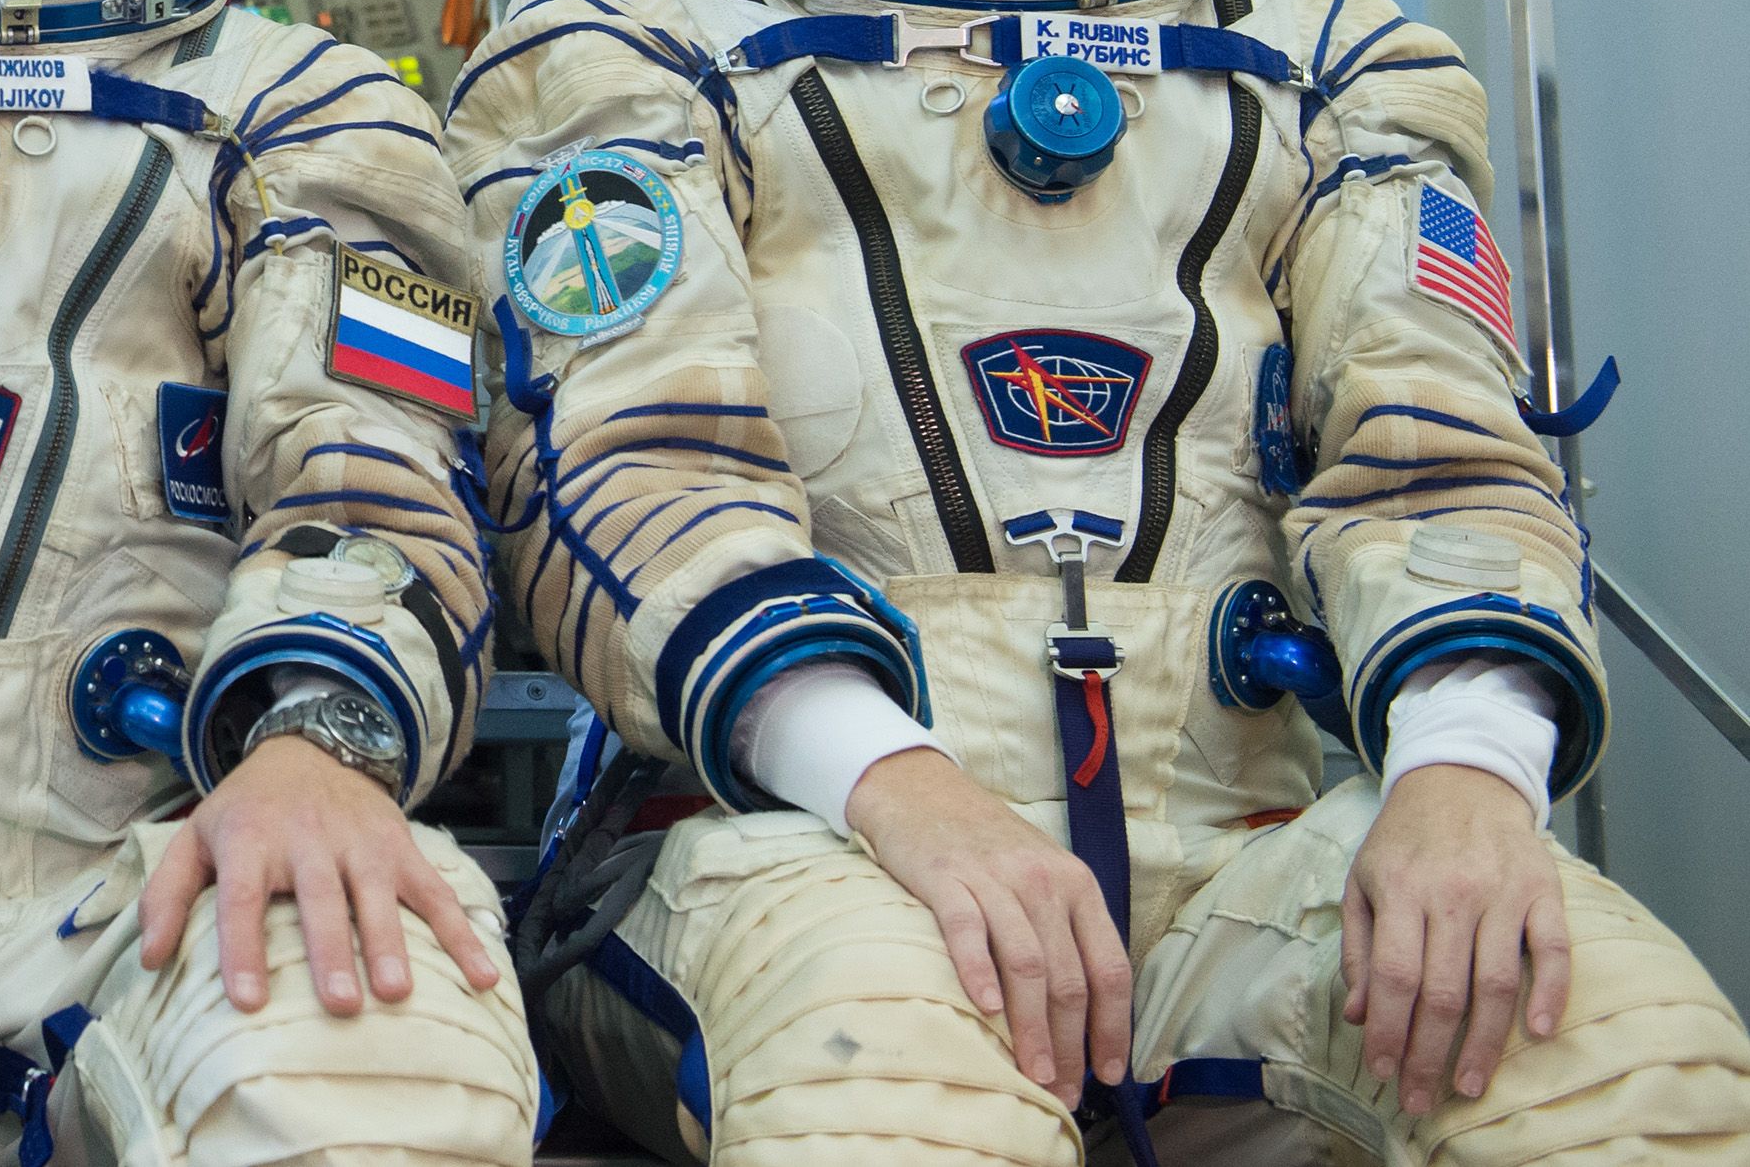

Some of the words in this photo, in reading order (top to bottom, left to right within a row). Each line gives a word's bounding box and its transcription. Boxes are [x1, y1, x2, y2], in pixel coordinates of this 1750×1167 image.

[1037, 19, 1059, 37] K.
[1069, 21, 1150, 45] RUBINS
[1067, 42, 1150, 66] РУБИНС
[344, 254, 472, 326] РОССИЯ
